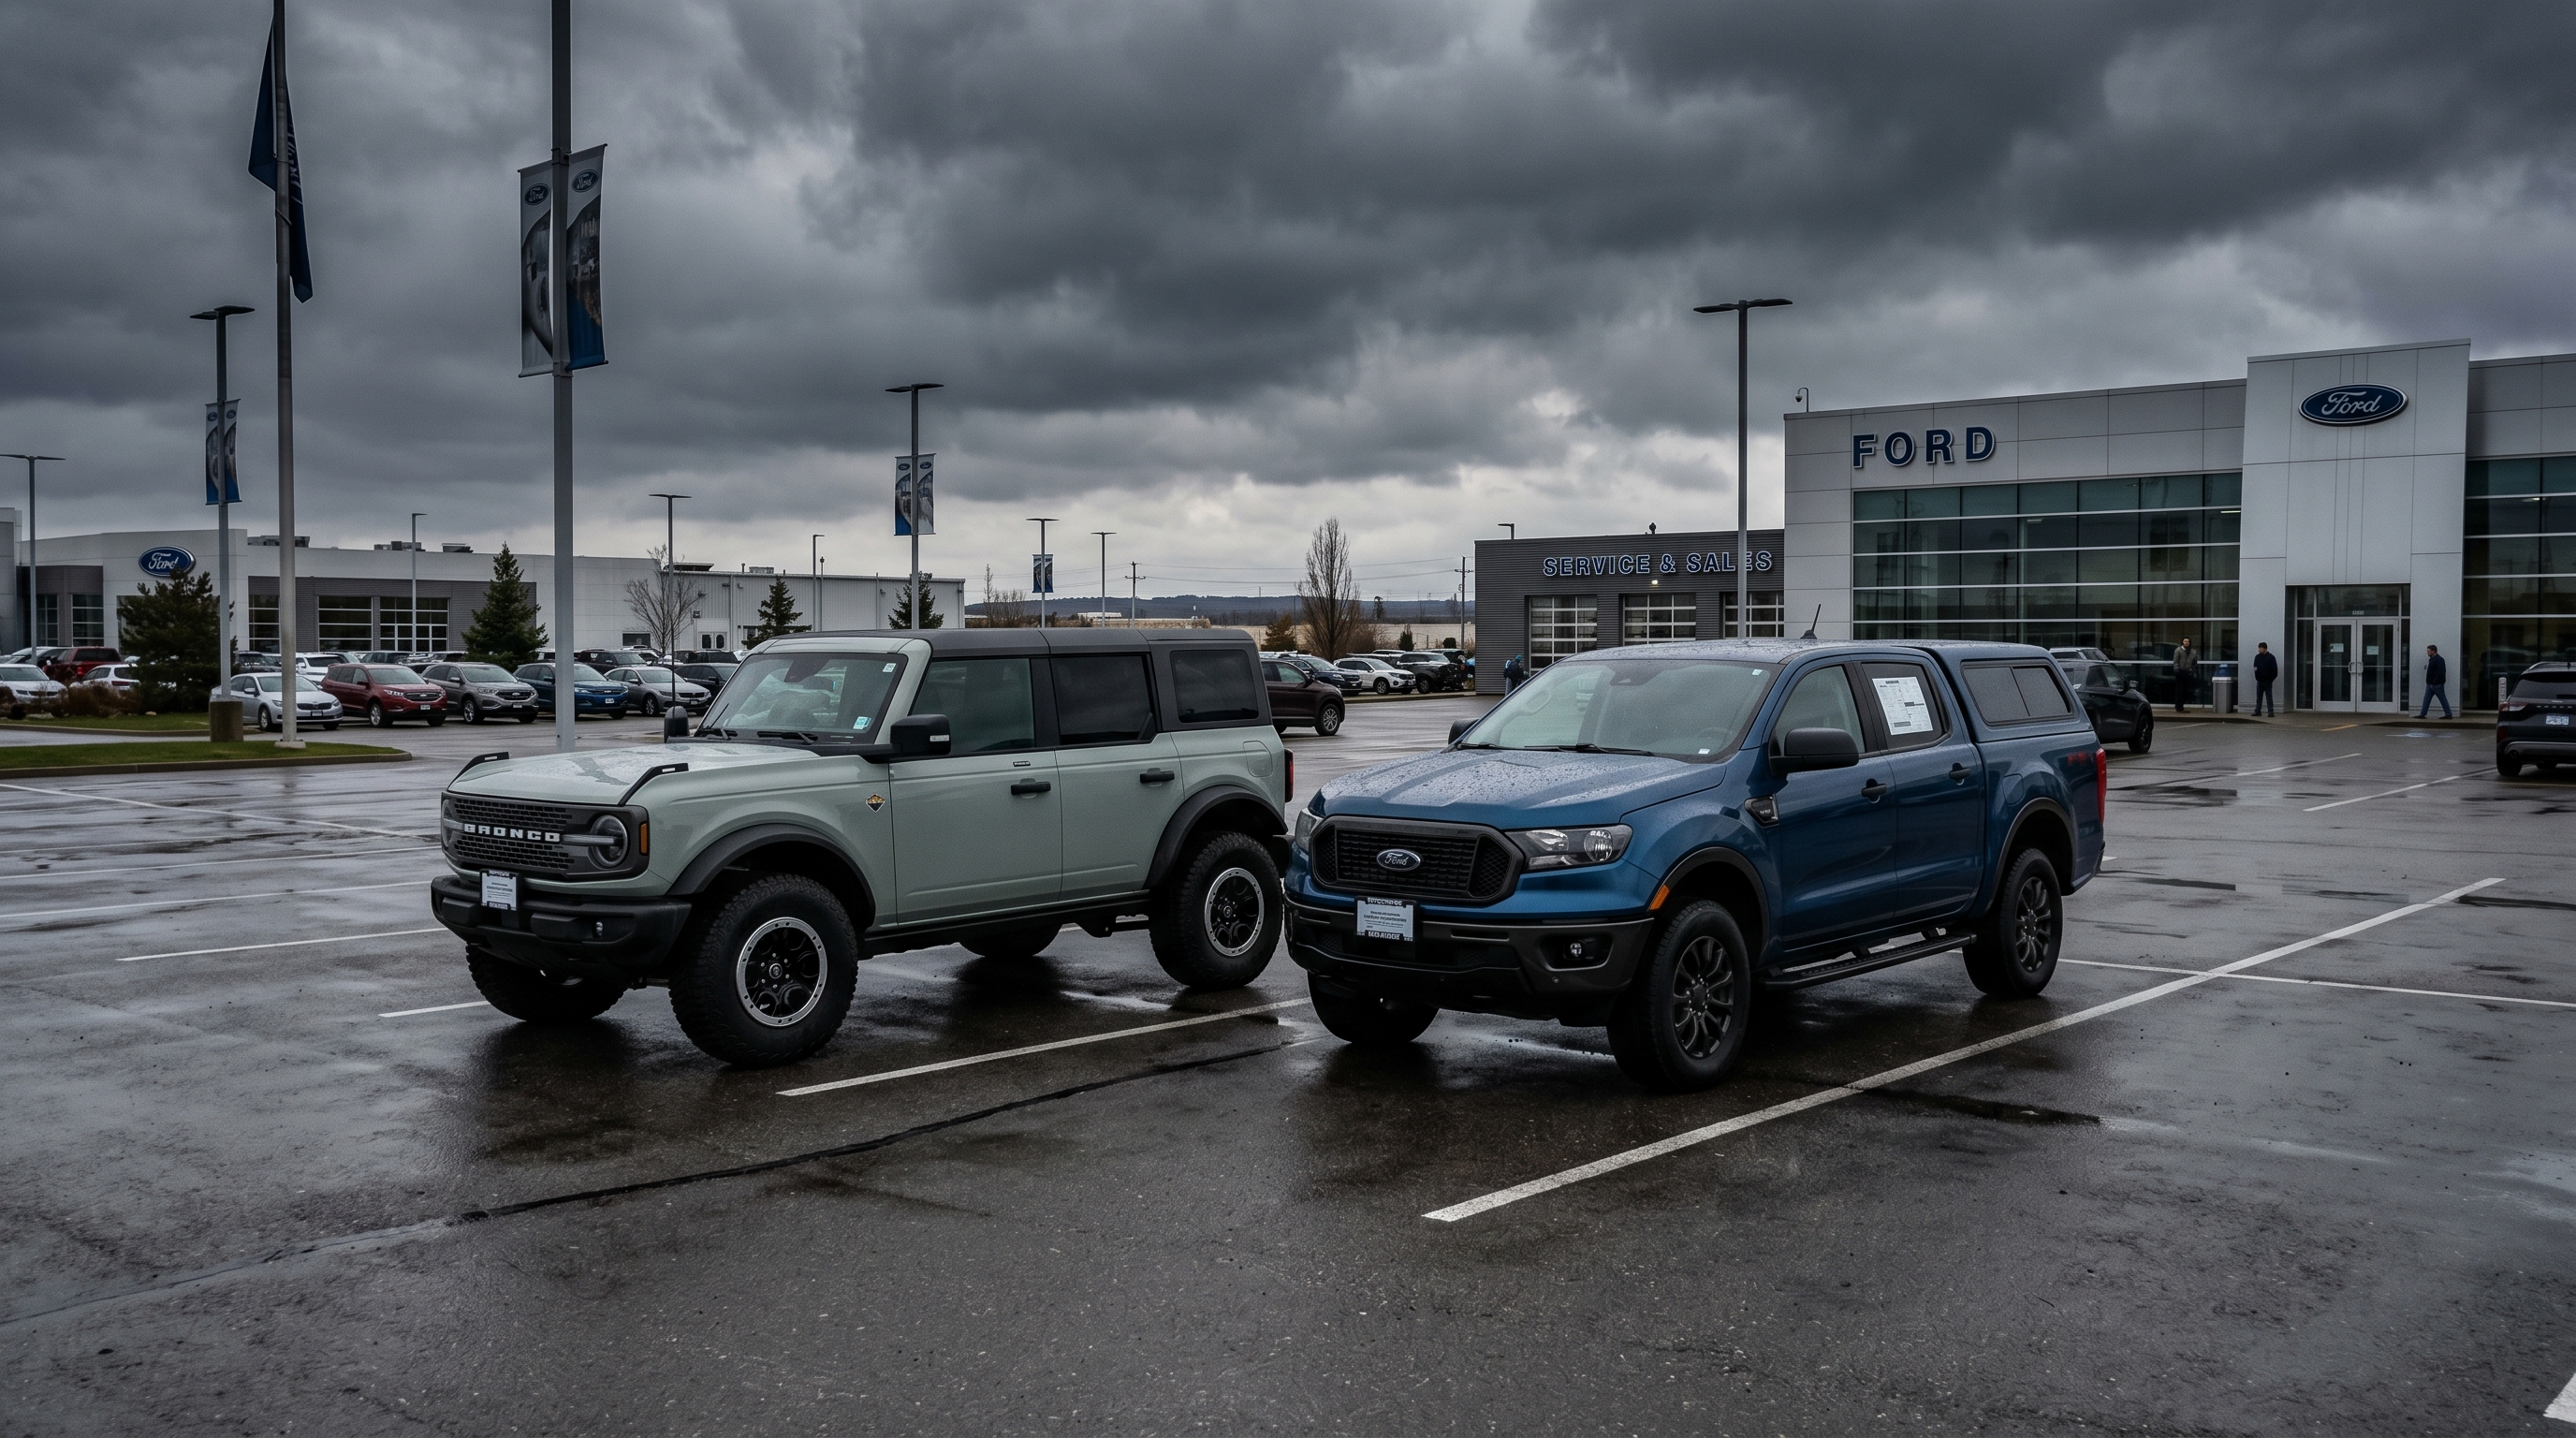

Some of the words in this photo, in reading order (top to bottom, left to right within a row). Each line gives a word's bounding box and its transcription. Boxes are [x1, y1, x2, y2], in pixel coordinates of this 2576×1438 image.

[2320, 390, 2382, 416] Ford
[1852, 426, 1996, 468] FORD
[148, 552, 179, 570] Ford
[1543, 554, 1650, 577] SERVICE
[1660, 553, 1676, 574] &
[463, 823, 561, 843] BRONCO
[1384, 852, 1410, 866] Ford
